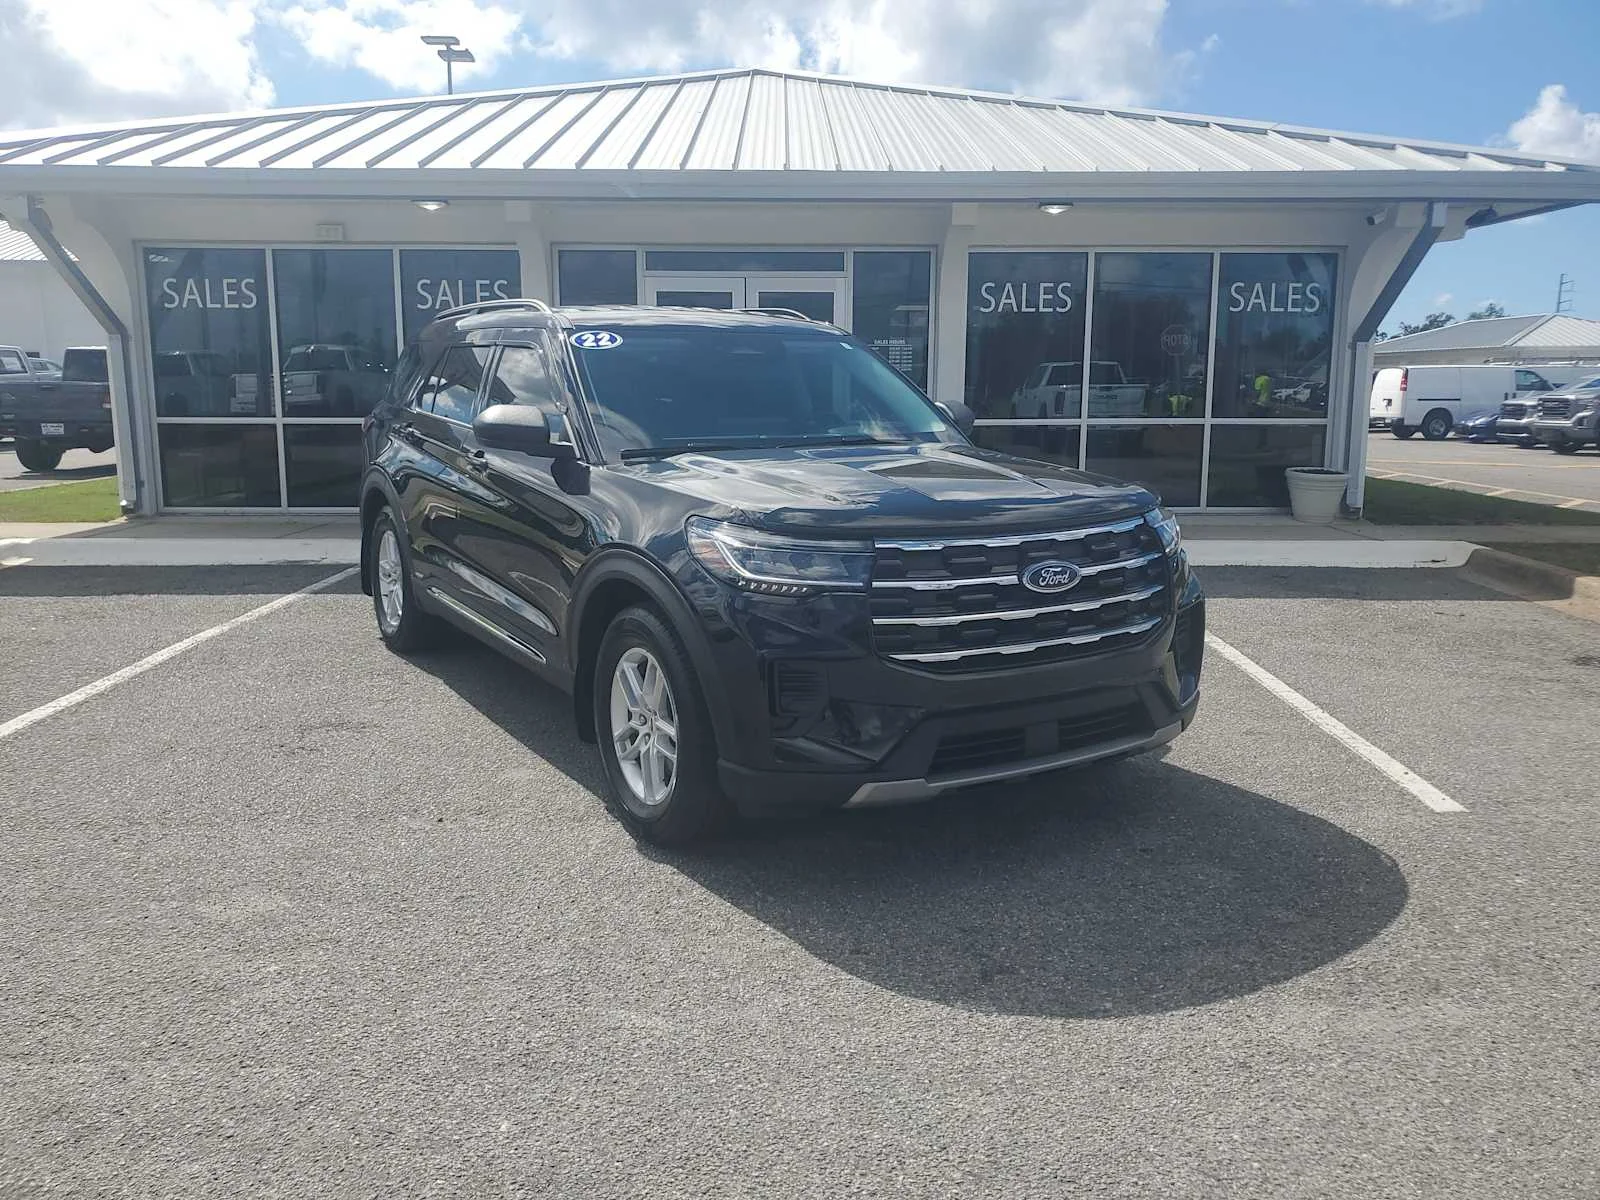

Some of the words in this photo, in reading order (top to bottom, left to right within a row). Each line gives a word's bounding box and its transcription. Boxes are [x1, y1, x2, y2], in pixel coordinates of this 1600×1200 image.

[162, 278, 258, 309] SALES
[416, 278, 509, 310] SALES
[978, 281, 1073, 314] SALES
[1228, 281, 1321, 314] SALES
[581, 333, 613, 347] 22
[1039, 567, 1071, 586] Ford
